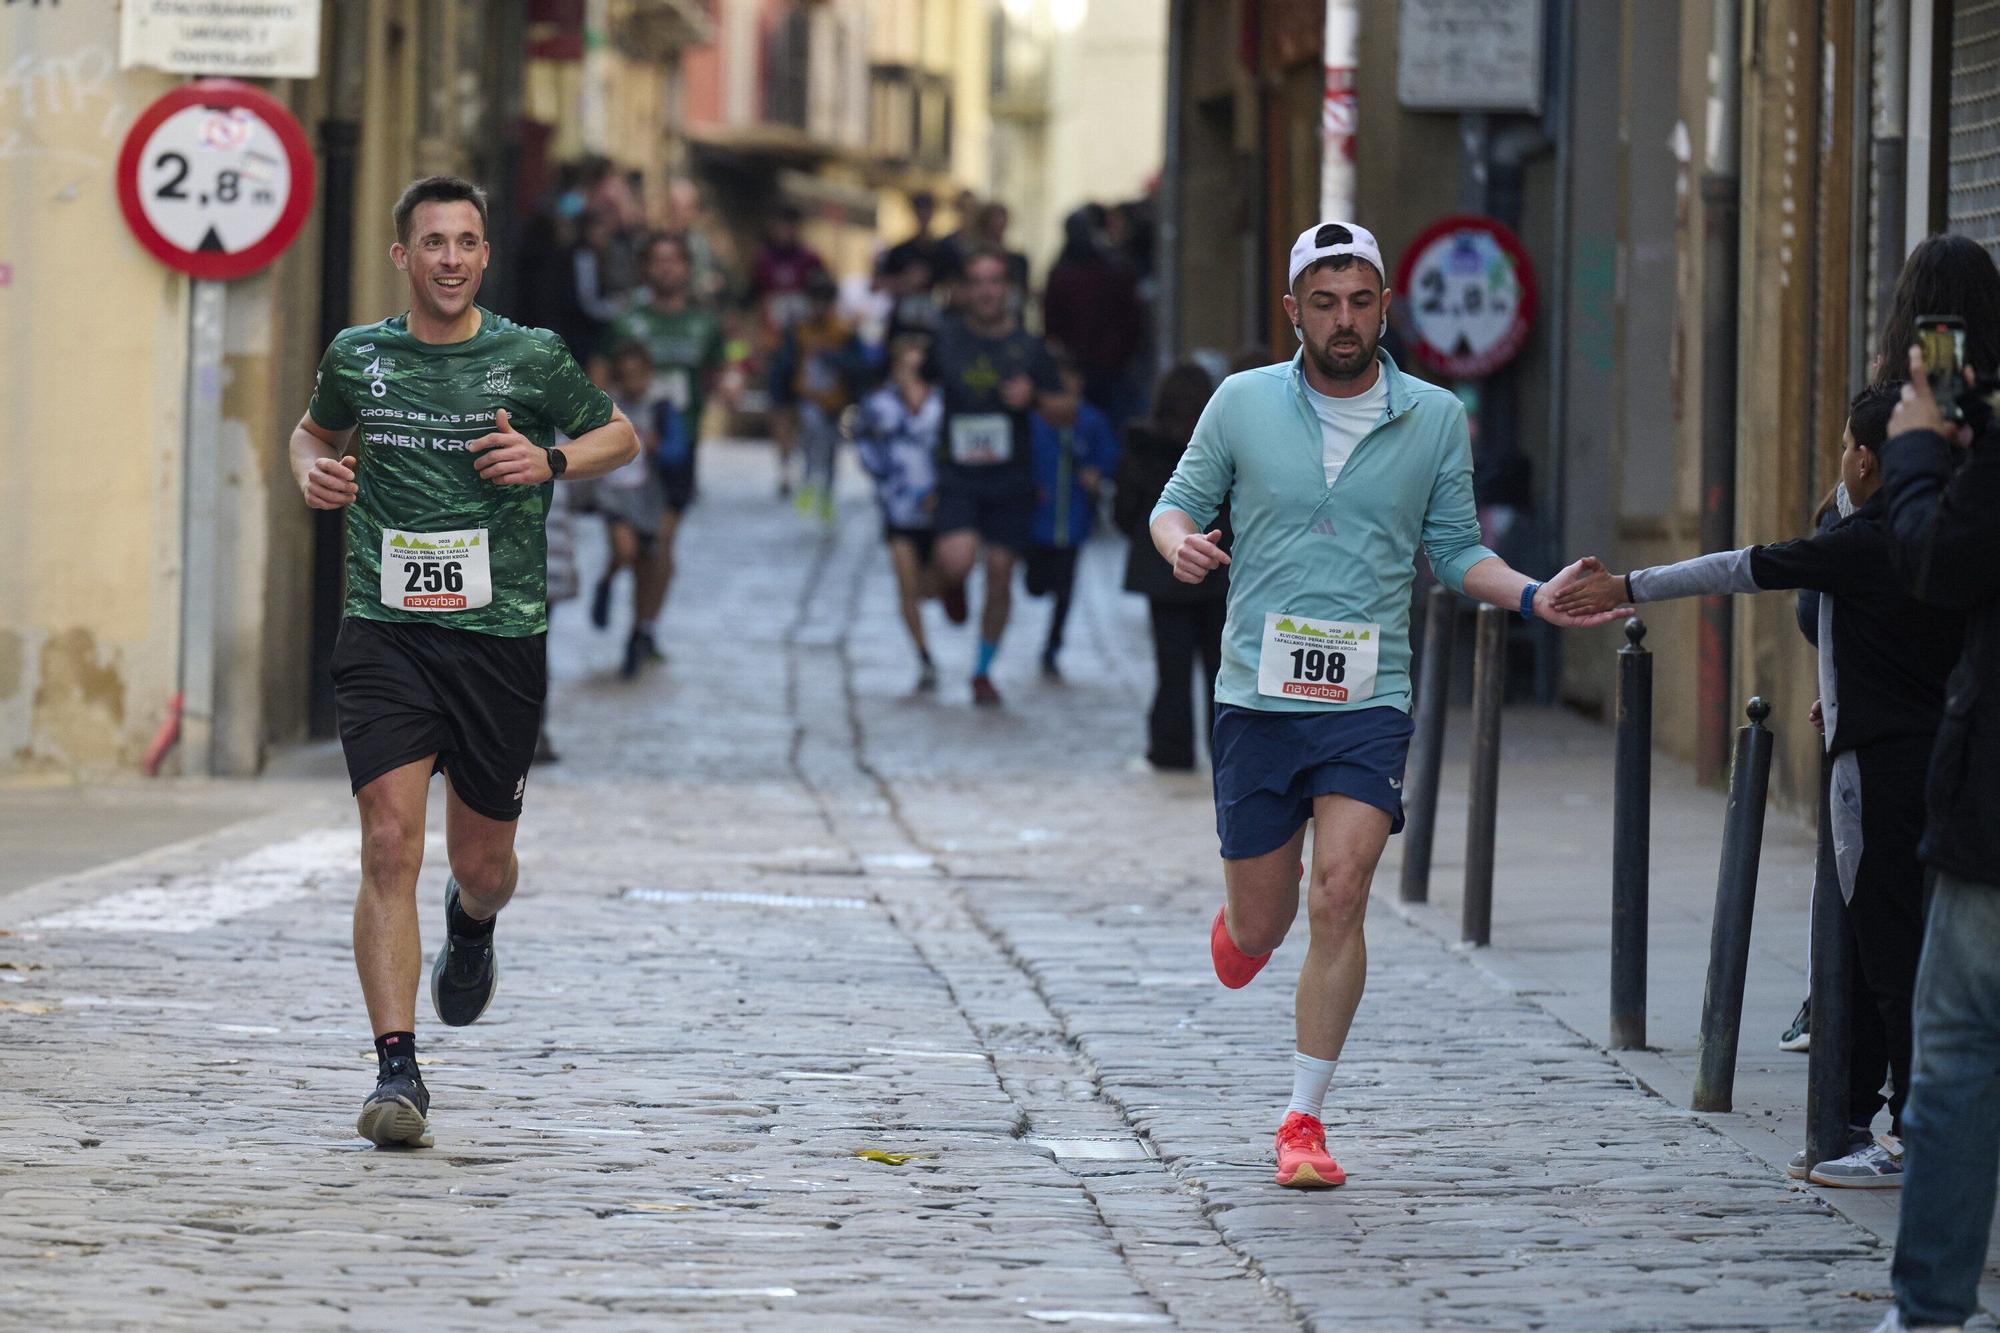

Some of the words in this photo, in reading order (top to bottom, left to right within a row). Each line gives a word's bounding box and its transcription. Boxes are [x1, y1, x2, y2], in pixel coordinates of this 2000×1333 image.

[360, 408, 404, 418] CROSS
[407, 411, 427, 421] DE
[430, 413, 461, 423] LAS
[464, 410, 513, 423] PEÑS
[404, 561, 463, 592] 256
[406, 595, 464, 606] navarban
[1274, 637, 1303, 646] TAFALLAKO
[1290, 648, 1346, 684] 198
[1286, 683, 1345, 698] navarban
